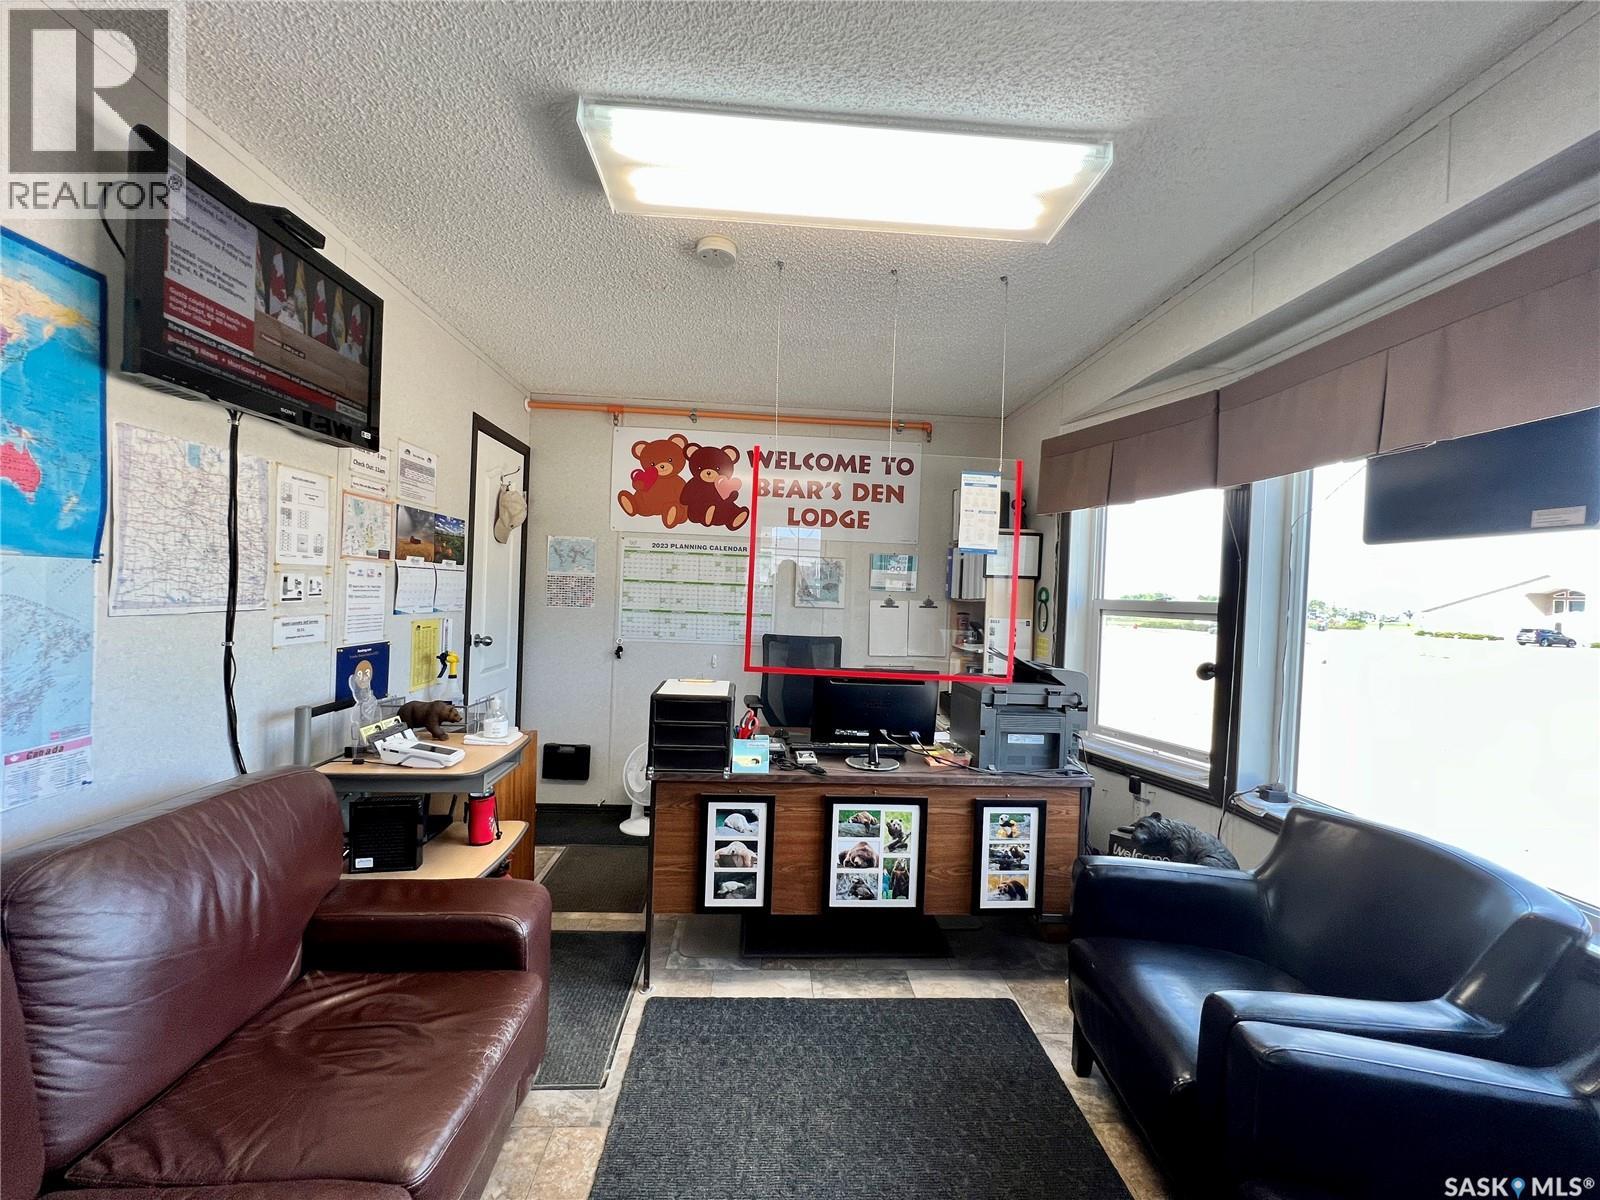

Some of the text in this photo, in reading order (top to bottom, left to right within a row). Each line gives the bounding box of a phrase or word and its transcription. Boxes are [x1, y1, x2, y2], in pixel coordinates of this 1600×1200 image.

[280, 407, 296, 416] SONY
[747, 450, 915, 476] WELCOME TO
[757, 478, 905, 504] BEAR'S DEN
[787, 507, 870, 530] LODGE
[670, 543, 708, 551] PLANNING
[26, 745, 64, 760] Canada
